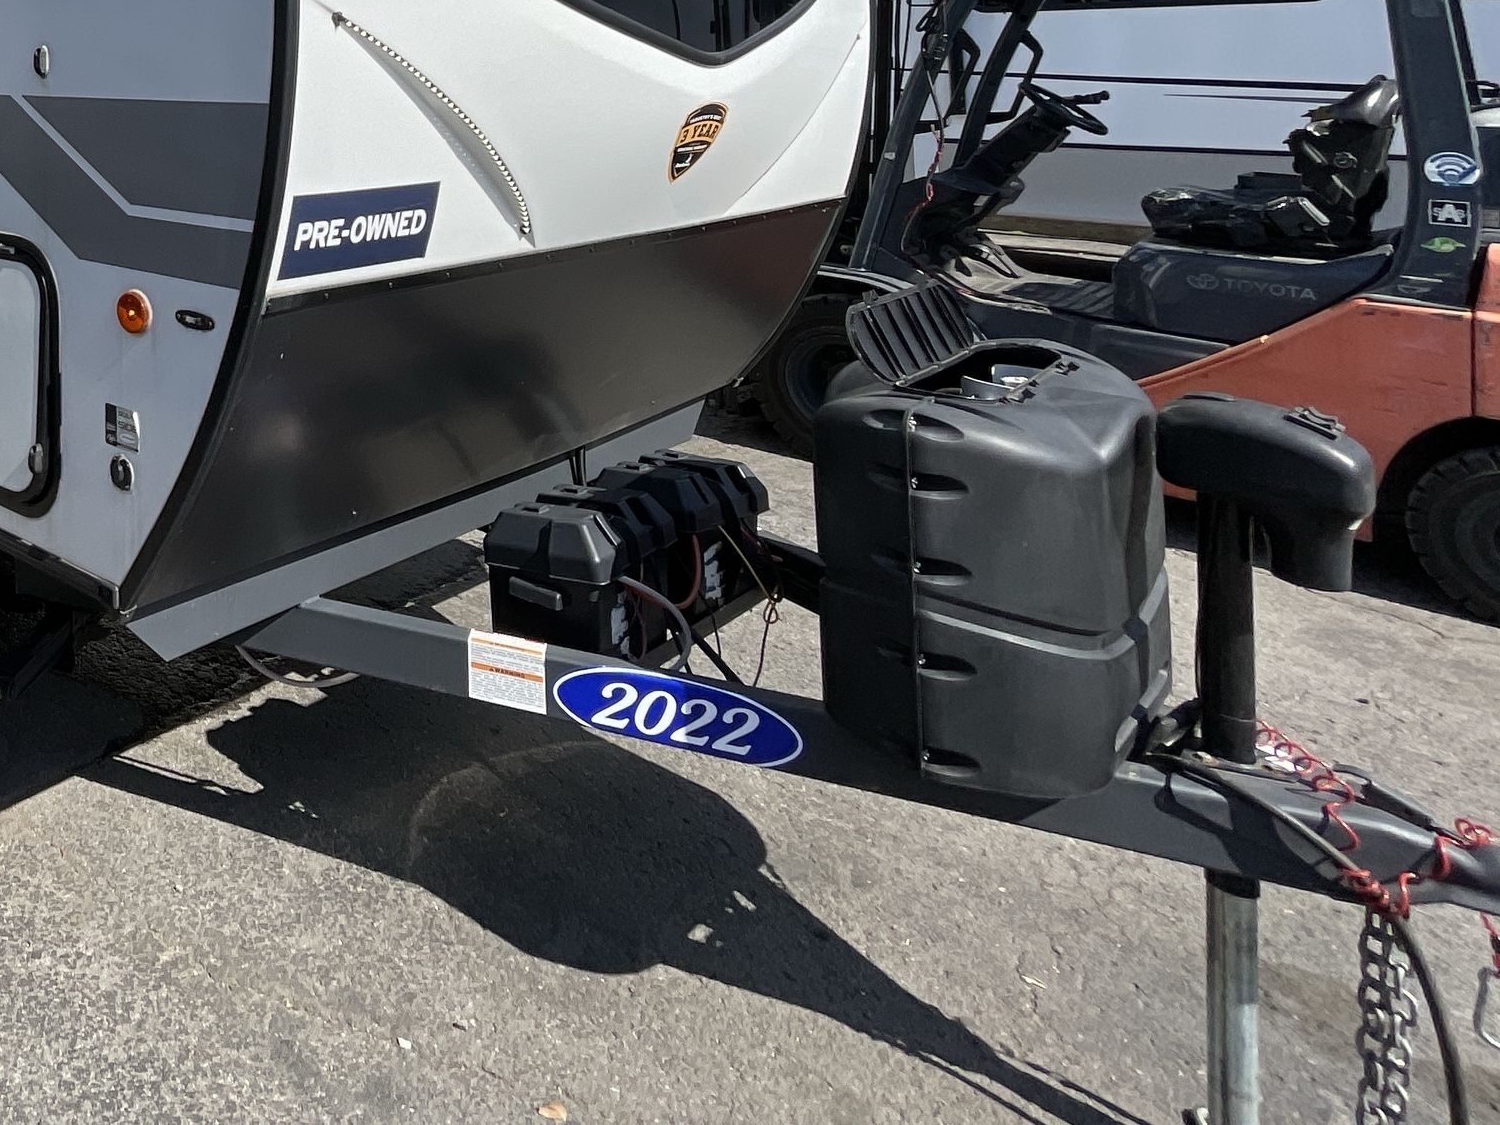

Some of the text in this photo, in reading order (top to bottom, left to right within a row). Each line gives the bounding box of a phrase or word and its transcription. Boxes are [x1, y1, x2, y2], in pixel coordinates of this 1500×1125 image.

[680, 123, 720, 143] 3 YEAR
[293, 208, 428, 252] PRE-OWNED
[1223, 277, 1317, 301] TOYOTA
[591, 682, 760, 755] 2022
